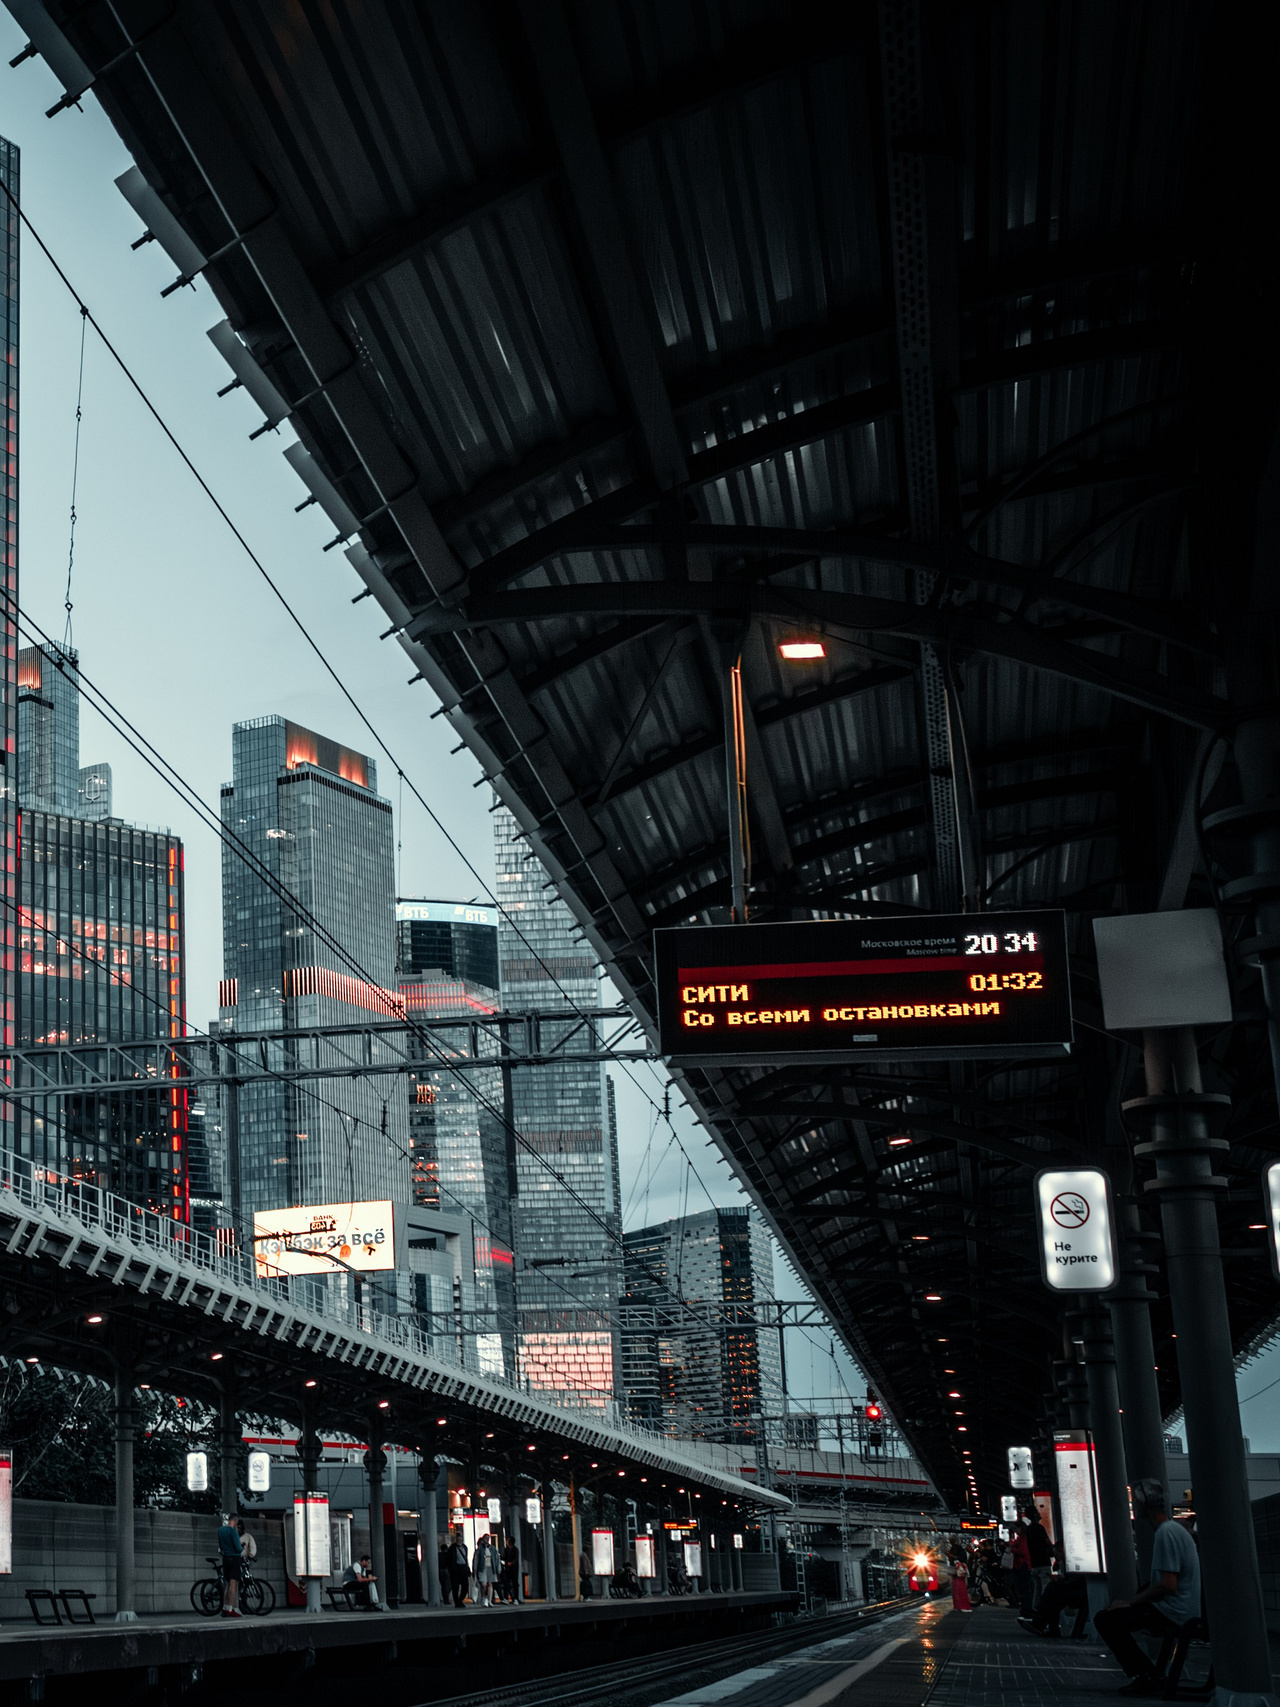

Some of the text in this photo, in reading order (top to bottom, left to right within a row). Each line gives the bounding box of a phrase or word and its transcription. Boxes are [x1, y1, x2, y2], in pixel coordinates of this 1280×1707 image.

[404, 906, 429, 919] ВТБ
[465, 909, 488, 922] ВТБ
[861, 936, 956, 948] Московское время
[964, 932, 1037, 955] 20 34
[970, 972, 1043, 991] 01:32
[683, 984, 748, 1003] СИТИ
[683, 1002, 1000, 1026] Со всеми остановками
[260, 1234, 324, 1255] Кэбэк
[352, 1228, 385, 1246] всё
[1054, 1241, 1072, 1251] Не
[1056, 1255, 1098, 1265] курите
